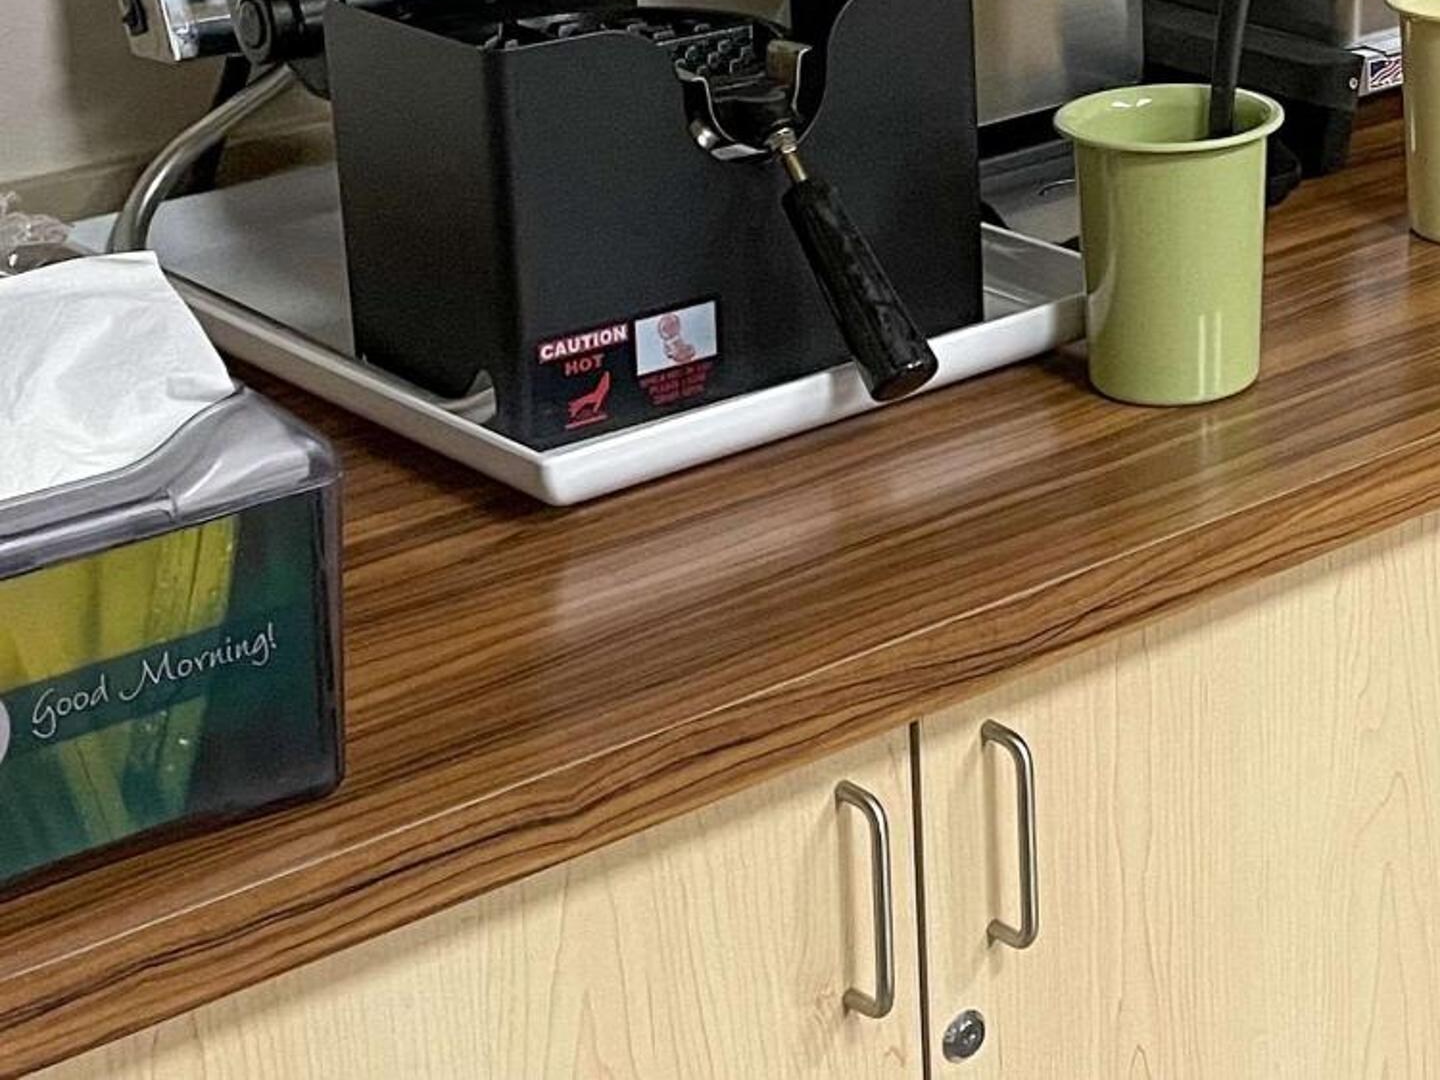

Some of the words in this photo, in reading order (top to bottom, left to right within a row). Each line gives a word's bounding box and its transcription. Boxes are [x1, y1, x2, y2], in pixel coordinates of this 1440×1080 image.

[539, 323, 629, 362] CAUTION
[564, 354, 605, 377] HOT
[31, 673, 111, 739] Good
[118, 622, 279, 702] Morning!
